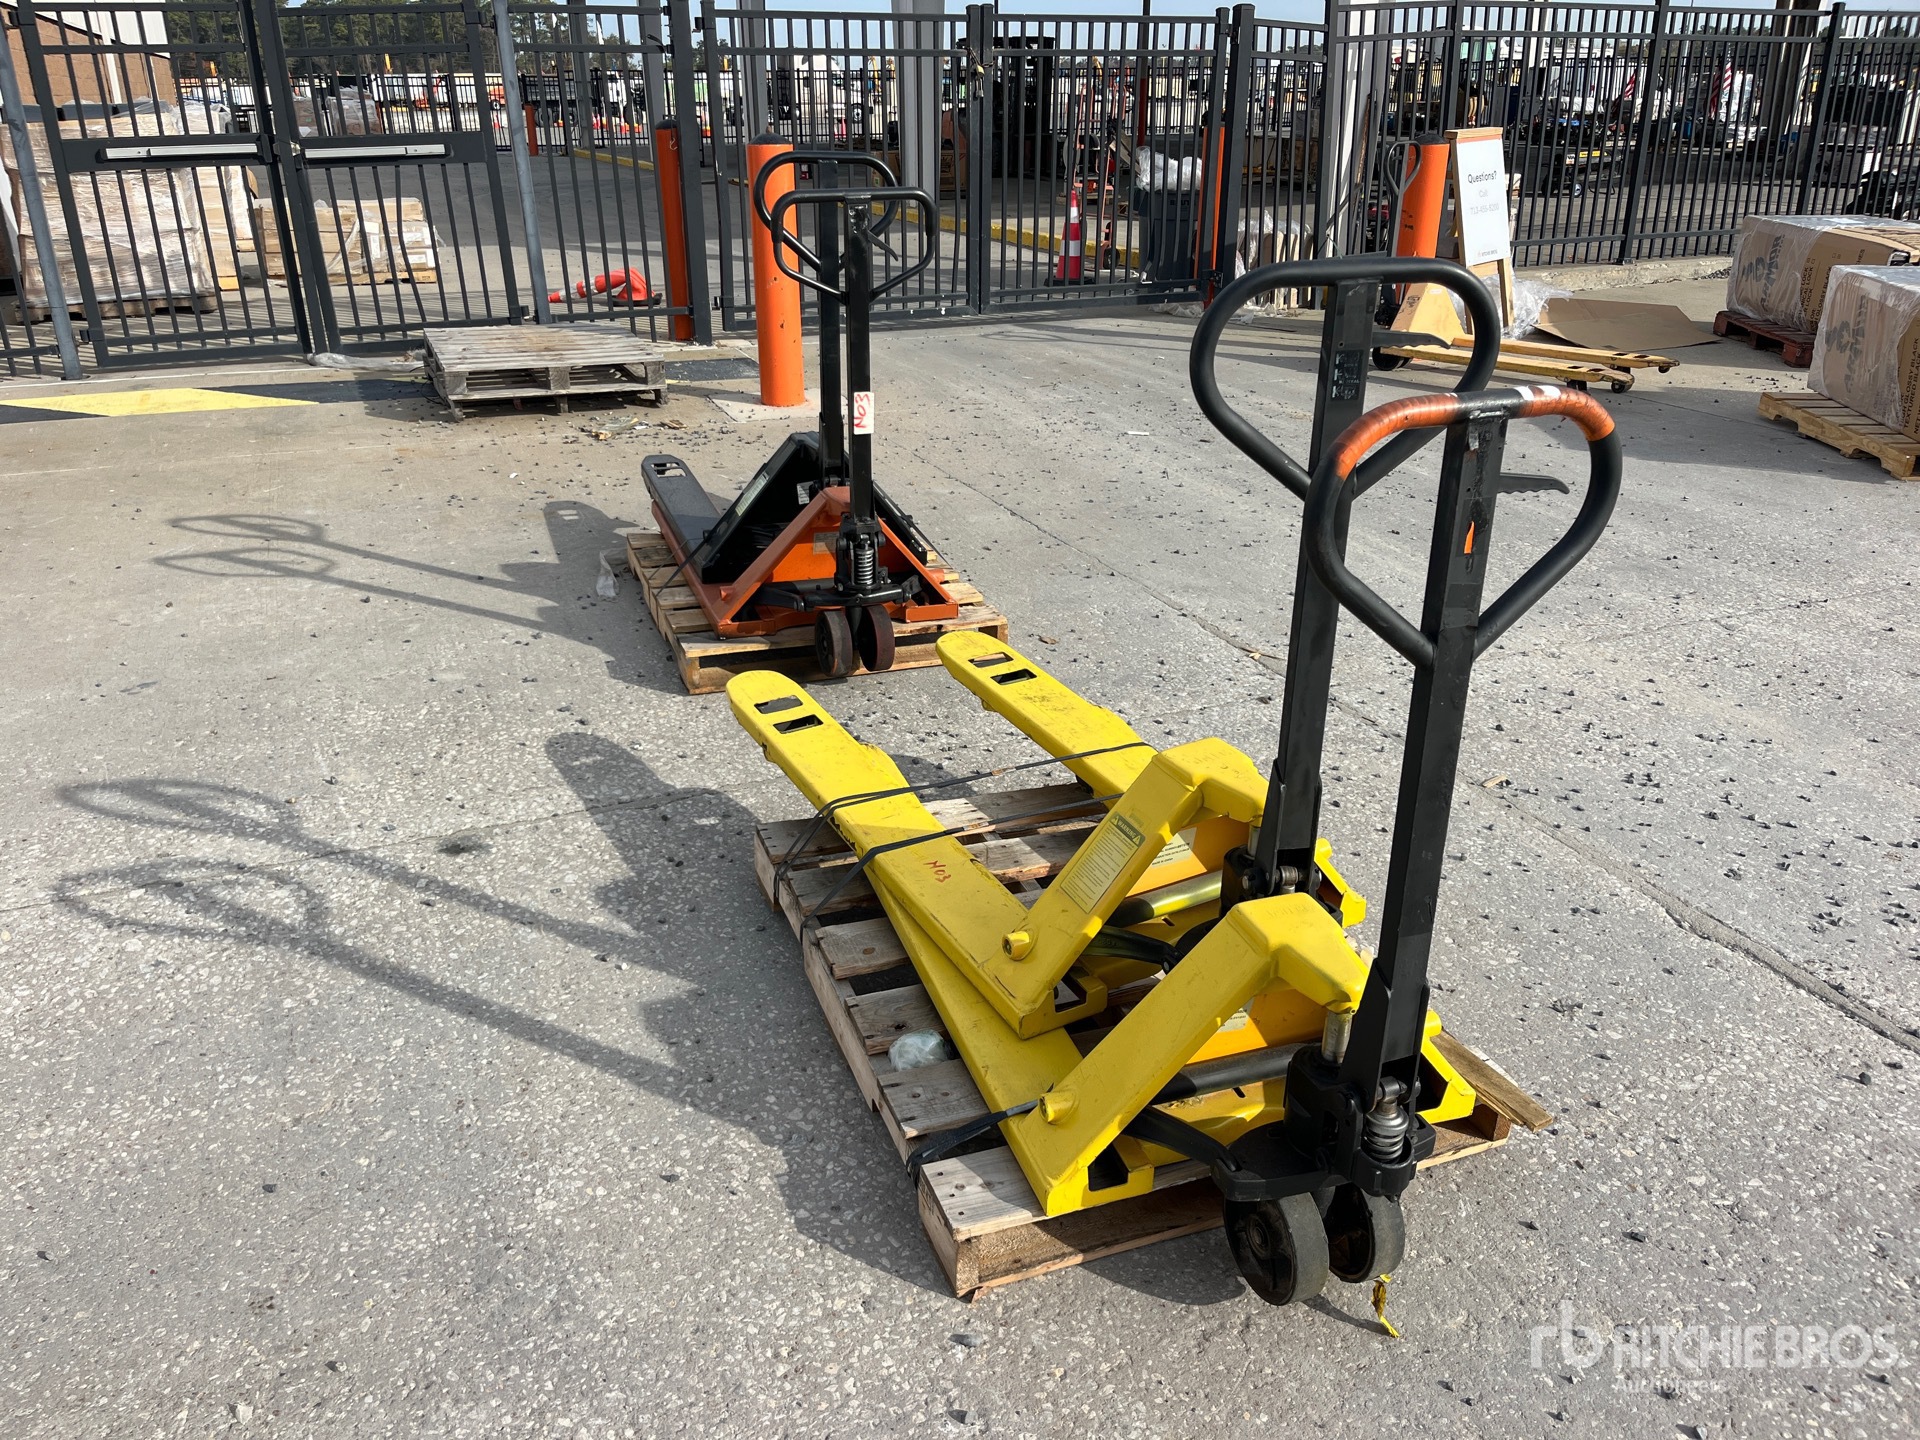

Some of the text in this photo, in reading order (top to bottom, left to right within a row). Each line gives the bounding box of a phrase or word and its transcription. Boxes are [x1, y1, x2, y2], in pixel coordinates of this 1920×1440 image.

[1468, 170, 1497, 184] Questions?
[1904, 369, 1914, 405] GLOSSY
[1910, 337, 1919, 368] BLACK
[1904, 384, 1917, 429] TEXTURED
